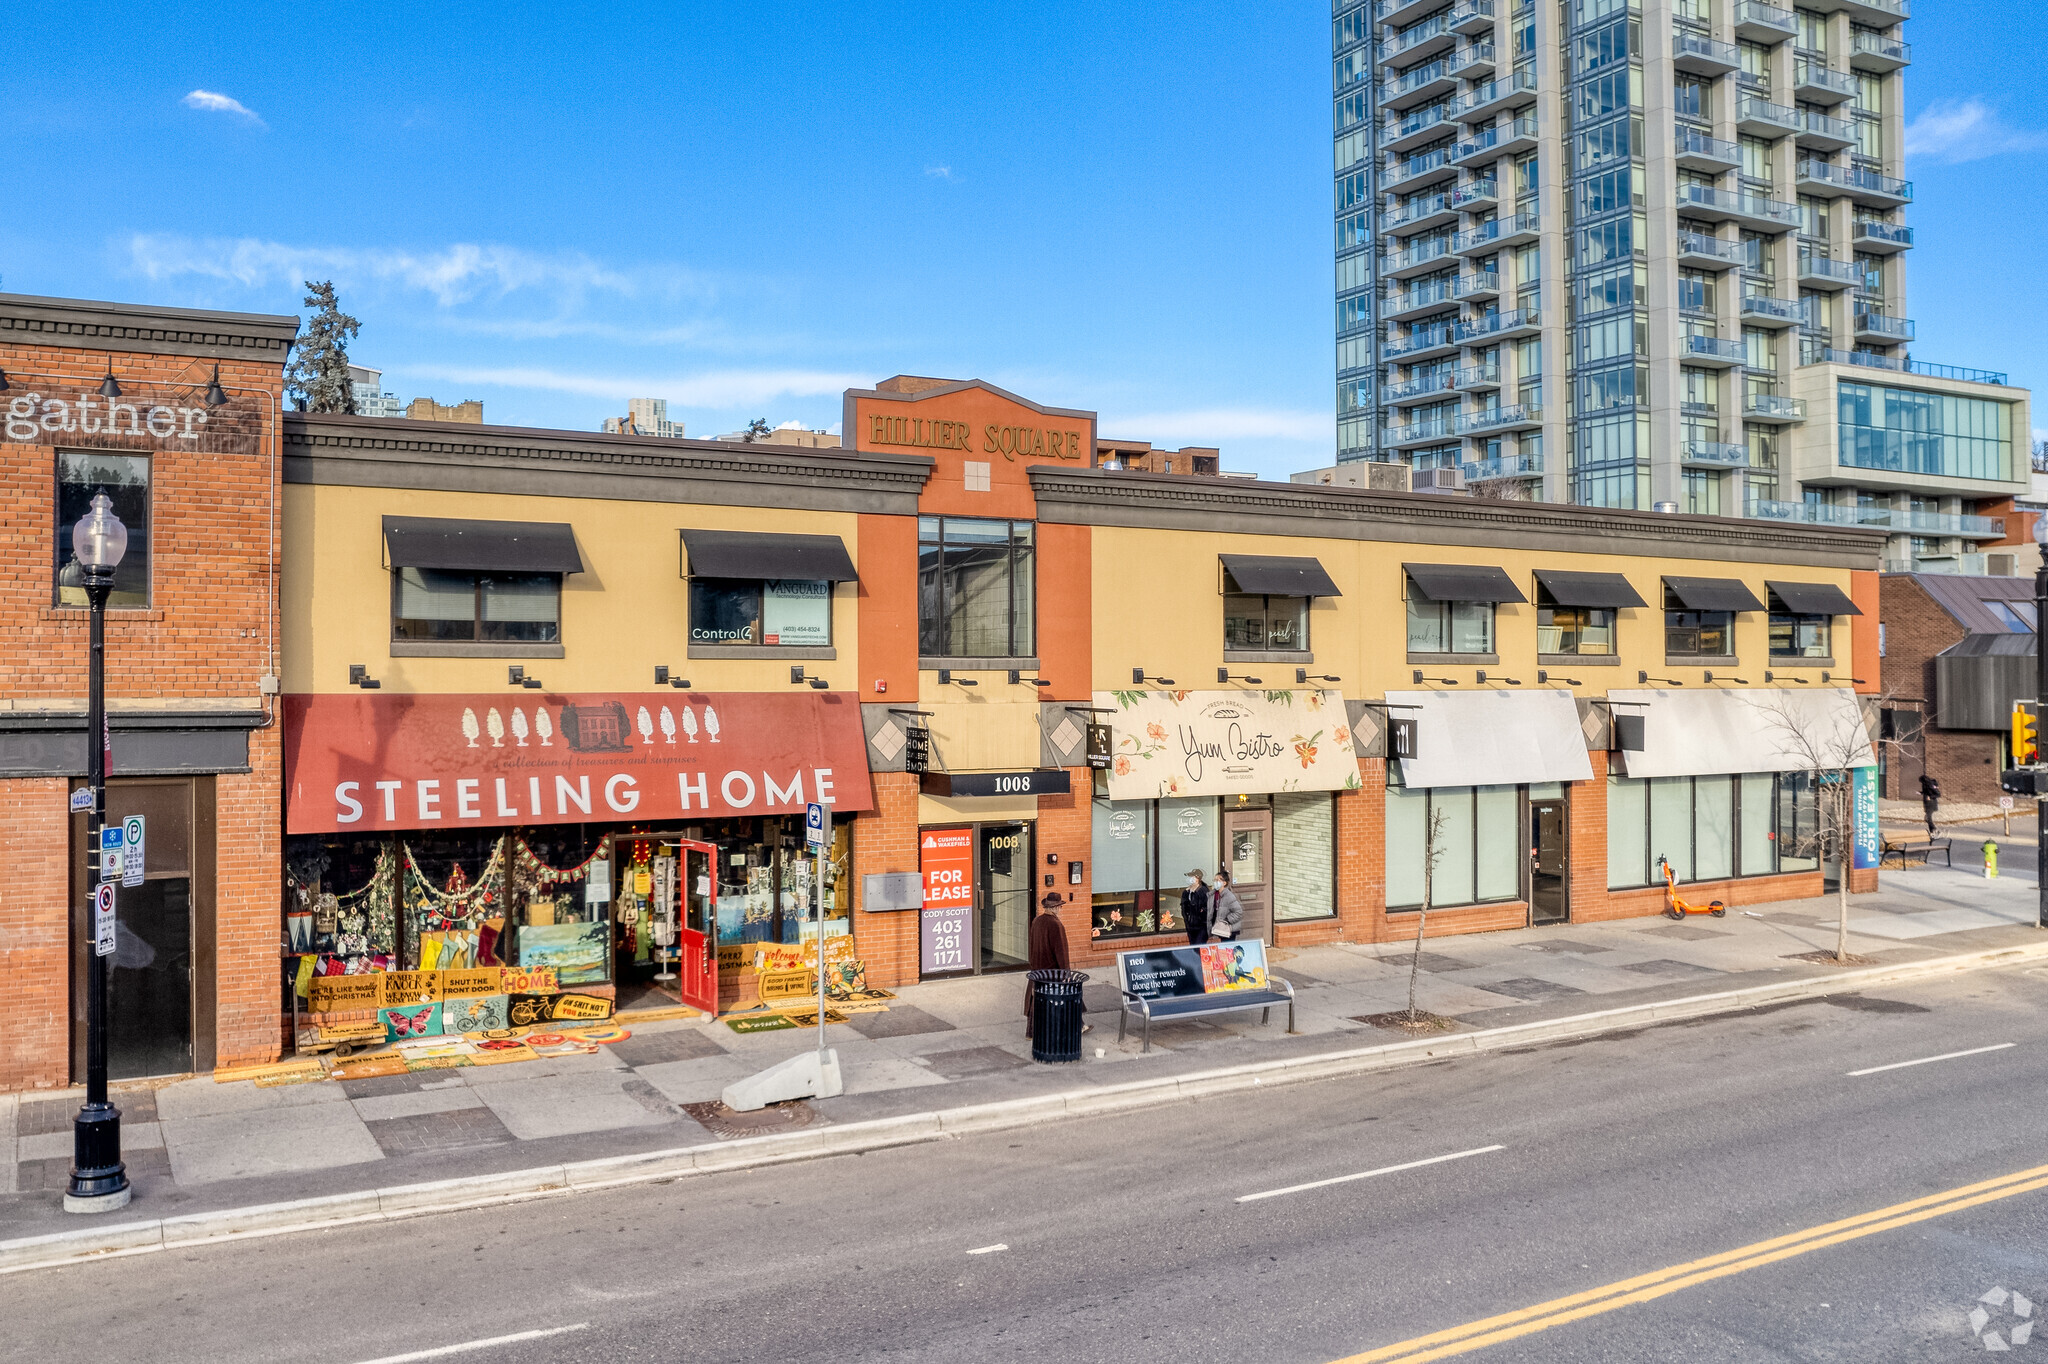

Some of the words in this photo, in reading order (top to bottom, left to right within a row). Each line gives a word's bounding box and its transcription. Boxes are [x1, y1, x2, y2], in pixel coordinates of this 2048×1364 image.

[5, 392, 209, 440] gather
[869, 413, 973, 453] HILLIER
[983, 423, 1082, 462] SQUARE
[766, 579, 828, 595] VANGUARD
[692, 625, 754, 641] Control4
[1206, 700, 1225, 709] FRESH
[1225, 700, 1245, 709] BREAD
[906, 738, 928, 752] HOME
[1178, 723, 1227, 783] Yum
[1228, 722, 1285, 761] Bistro
[503, 756, 559, 768] collection
[561, 757, 573, 769] of
[576, 757, 625, 766] treasures
[627, 755, 648, 765] and
[650, 755, 698, 766] surprises
[994, 776, 1031, 793] 1008
[76, 794, 89, 806] 4413
[335, 773, 641, 824] STEELING
[678, 768, 837, 811] HOME
[1867, 769, 1876, 823] LEASE
[130, 824, 139, 841] P
[989, 836, 1019, 850] 1008
[1867, 827, 1876, 862] FOR
[930, 869, 963, 884] FOR
[923, 885, 971, 902] LEASE
[923, 910, 945, 918] CODY
[945, 908, 970, 917] SCOTT
[932, 919, 962, 935] 403
[935, 935, 961, 950] 261
[933, 950, 962, 965] 1171
[1129, 957, 1145, 966] neo
[472, 977, 489, 985] THE
[1131, 971, 1159, 981] Discover
[1159, 968, 1187, 979] rewards
[310, 986, 333, 995] WE'RE
[336, 985, 353, 993] LIKE
[354, 982, 378, 993] really
[386, 979, 422, 990] KNOCK
[504, 973, 553, 991] HOME
[766, 984, 784, 992] BRING
[1132, 981, 1151, 991] along
[1150, 980, 1161, 989] the
[1161, 979, 1177, 989] way.
[332, 992, 376, 1001] CHRISTMAS
[443, 987, 470, 995] FRONT
[471, 985, 495, 993] DOOR
[562, 1008, 577, 1017] YOU
[573, 1000, 590, 1009] SHIT
[590, 1004, 605, 1012] NOT
